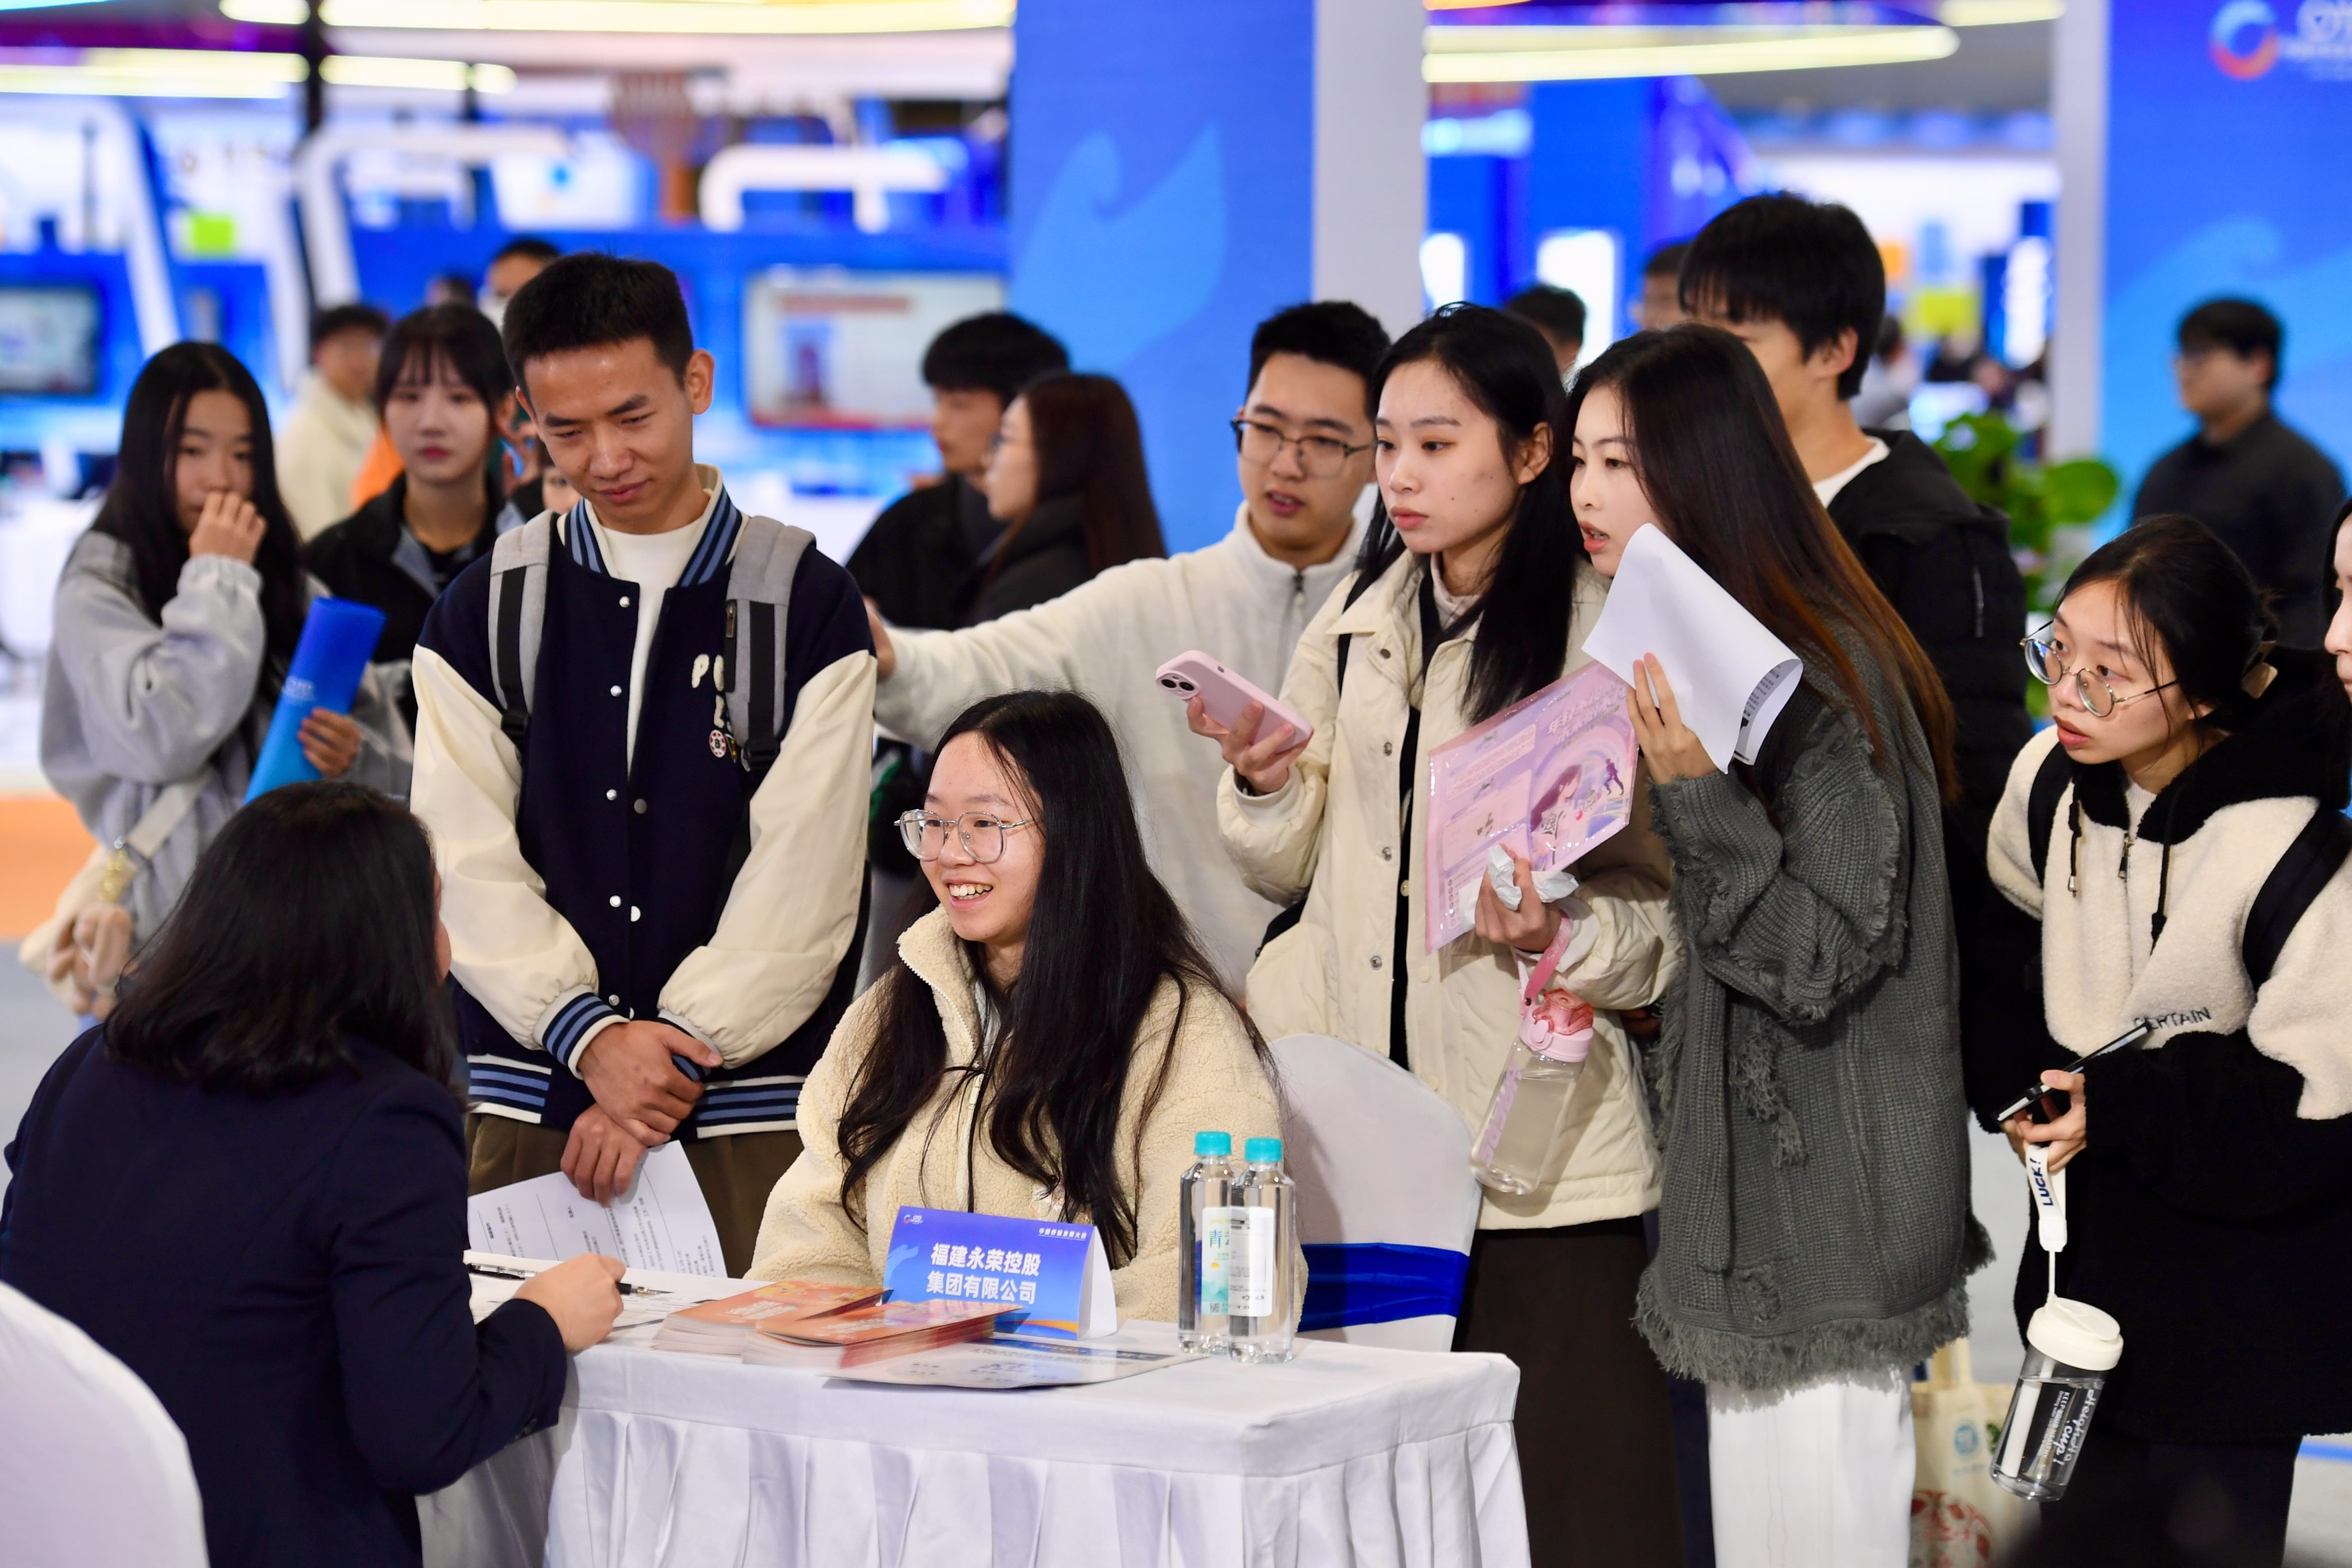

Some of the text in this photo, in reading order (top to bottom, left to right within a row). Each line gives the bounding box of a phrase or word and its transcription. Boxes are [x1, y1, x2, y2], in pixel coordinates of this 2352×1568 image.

[930, 1242, 1041, 1277] 福建永荣控股
[926, 1270, 1037, 1305] 集团有限公司
[2059, 1391, 2071, 1409] KEEP
